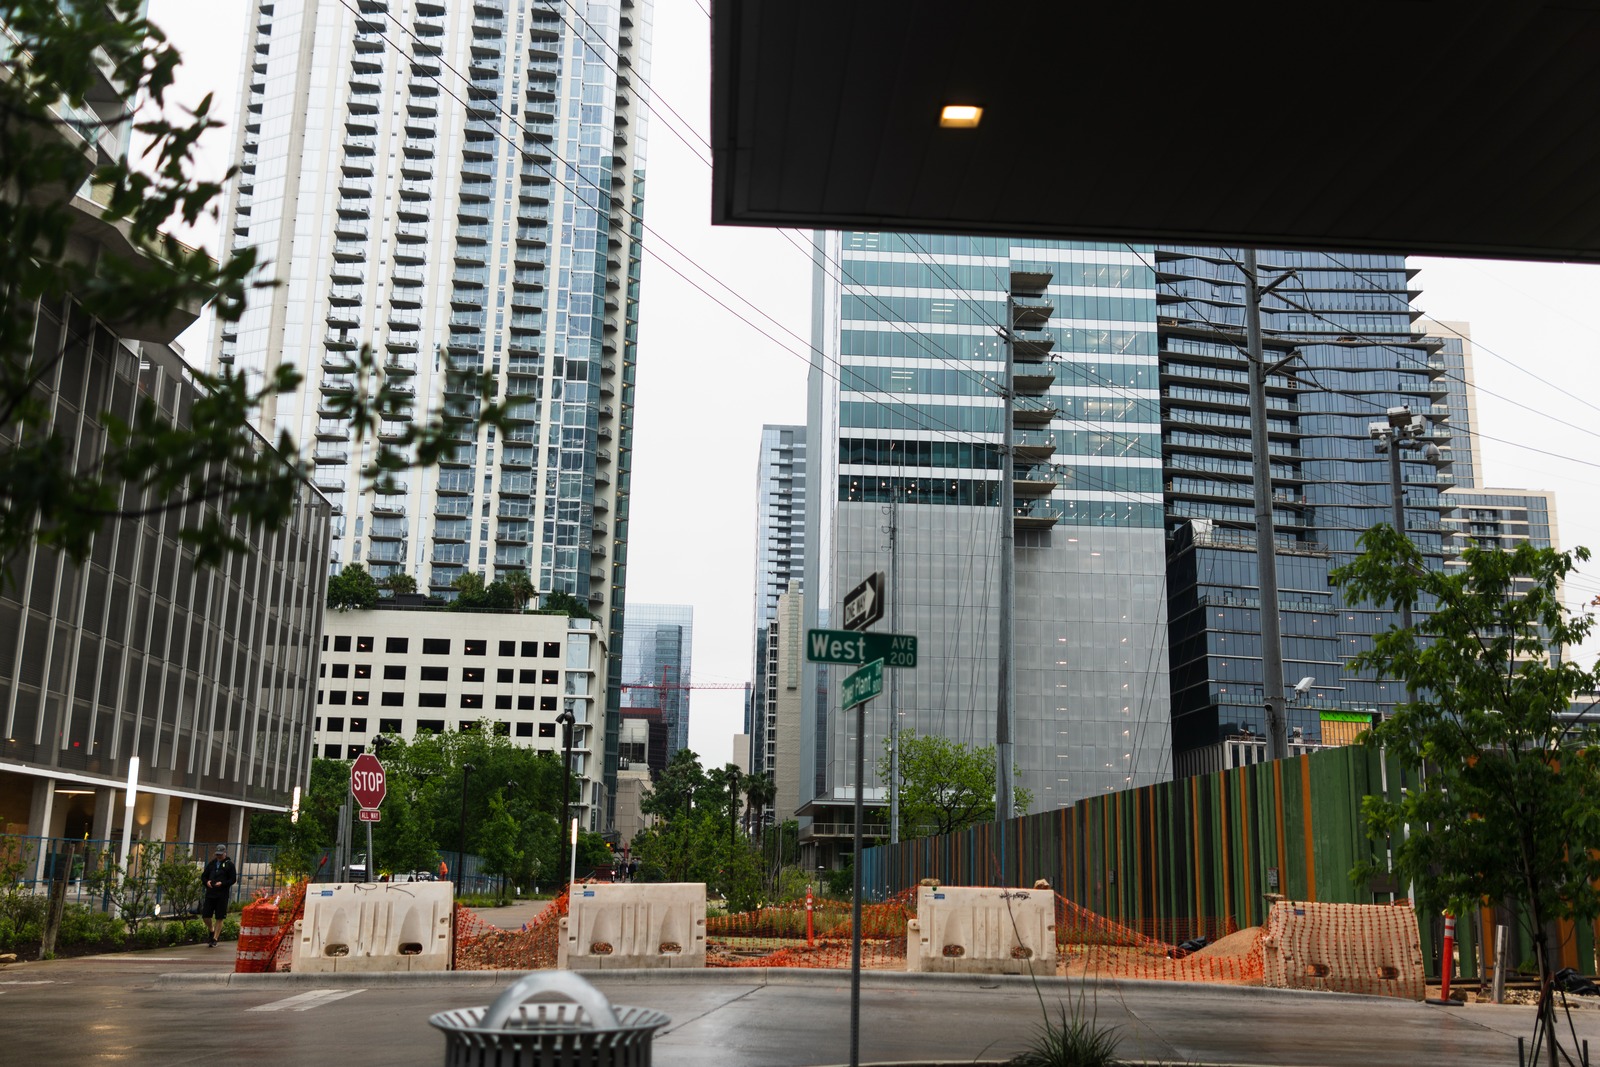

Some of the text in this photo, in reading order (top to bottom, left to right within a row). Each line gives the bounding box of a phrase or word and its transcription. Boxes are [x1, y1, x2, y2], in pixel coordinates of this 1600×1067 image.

[846, 592, 865, 622] ONE WAY
[812, 634, 914, 660] West AVE
[890, 652, 914, 666] 200
[854, 670, 871, 697] Plant
[354, 770, 383, 792] STOP
